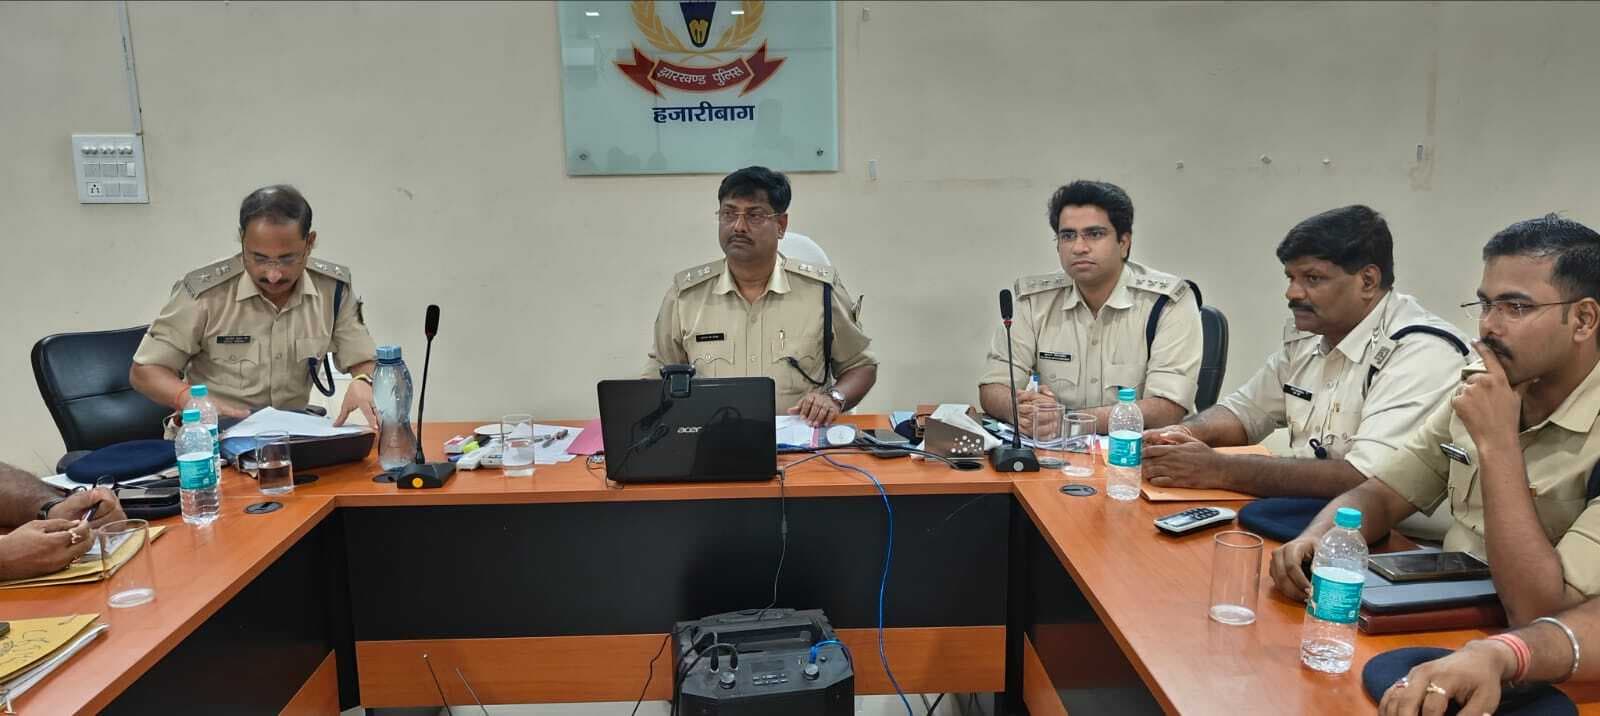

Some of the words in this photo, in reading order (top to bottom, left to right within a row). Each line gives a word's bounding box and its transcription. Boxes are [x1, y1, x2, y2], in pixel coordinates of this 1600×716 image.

[656, 67, 706, 85] झारखण्ड
[712, 66, 744, 86] पुलिस
[652, 101, 755, 123] हजारीबाग
